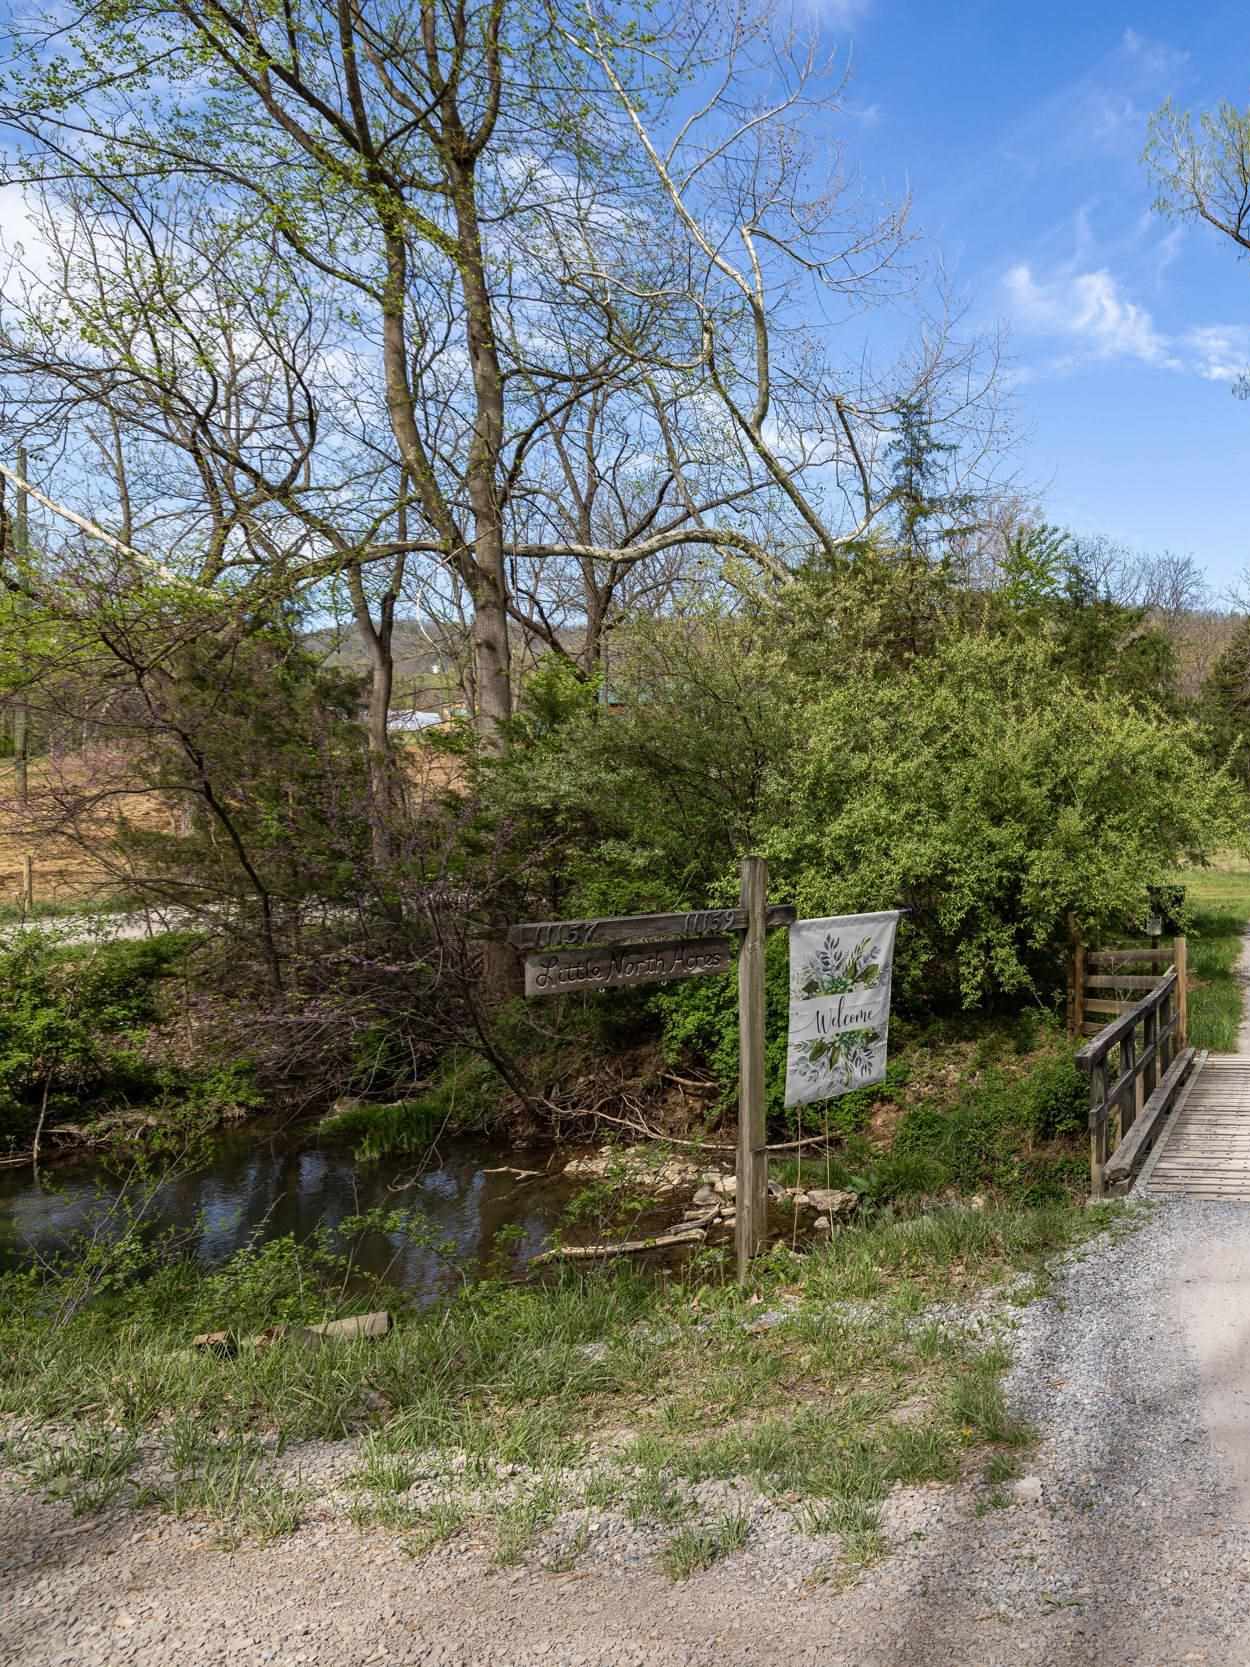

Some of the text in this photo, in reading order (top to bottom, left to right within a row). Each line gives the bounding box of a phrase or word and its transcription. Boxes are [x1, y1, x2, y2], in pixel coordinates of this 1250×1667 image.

[535, 921, 599, 945] 11157
[535, 946, 721, 988] Little North Acres
[815, 995, 873, 1034] Welcome
